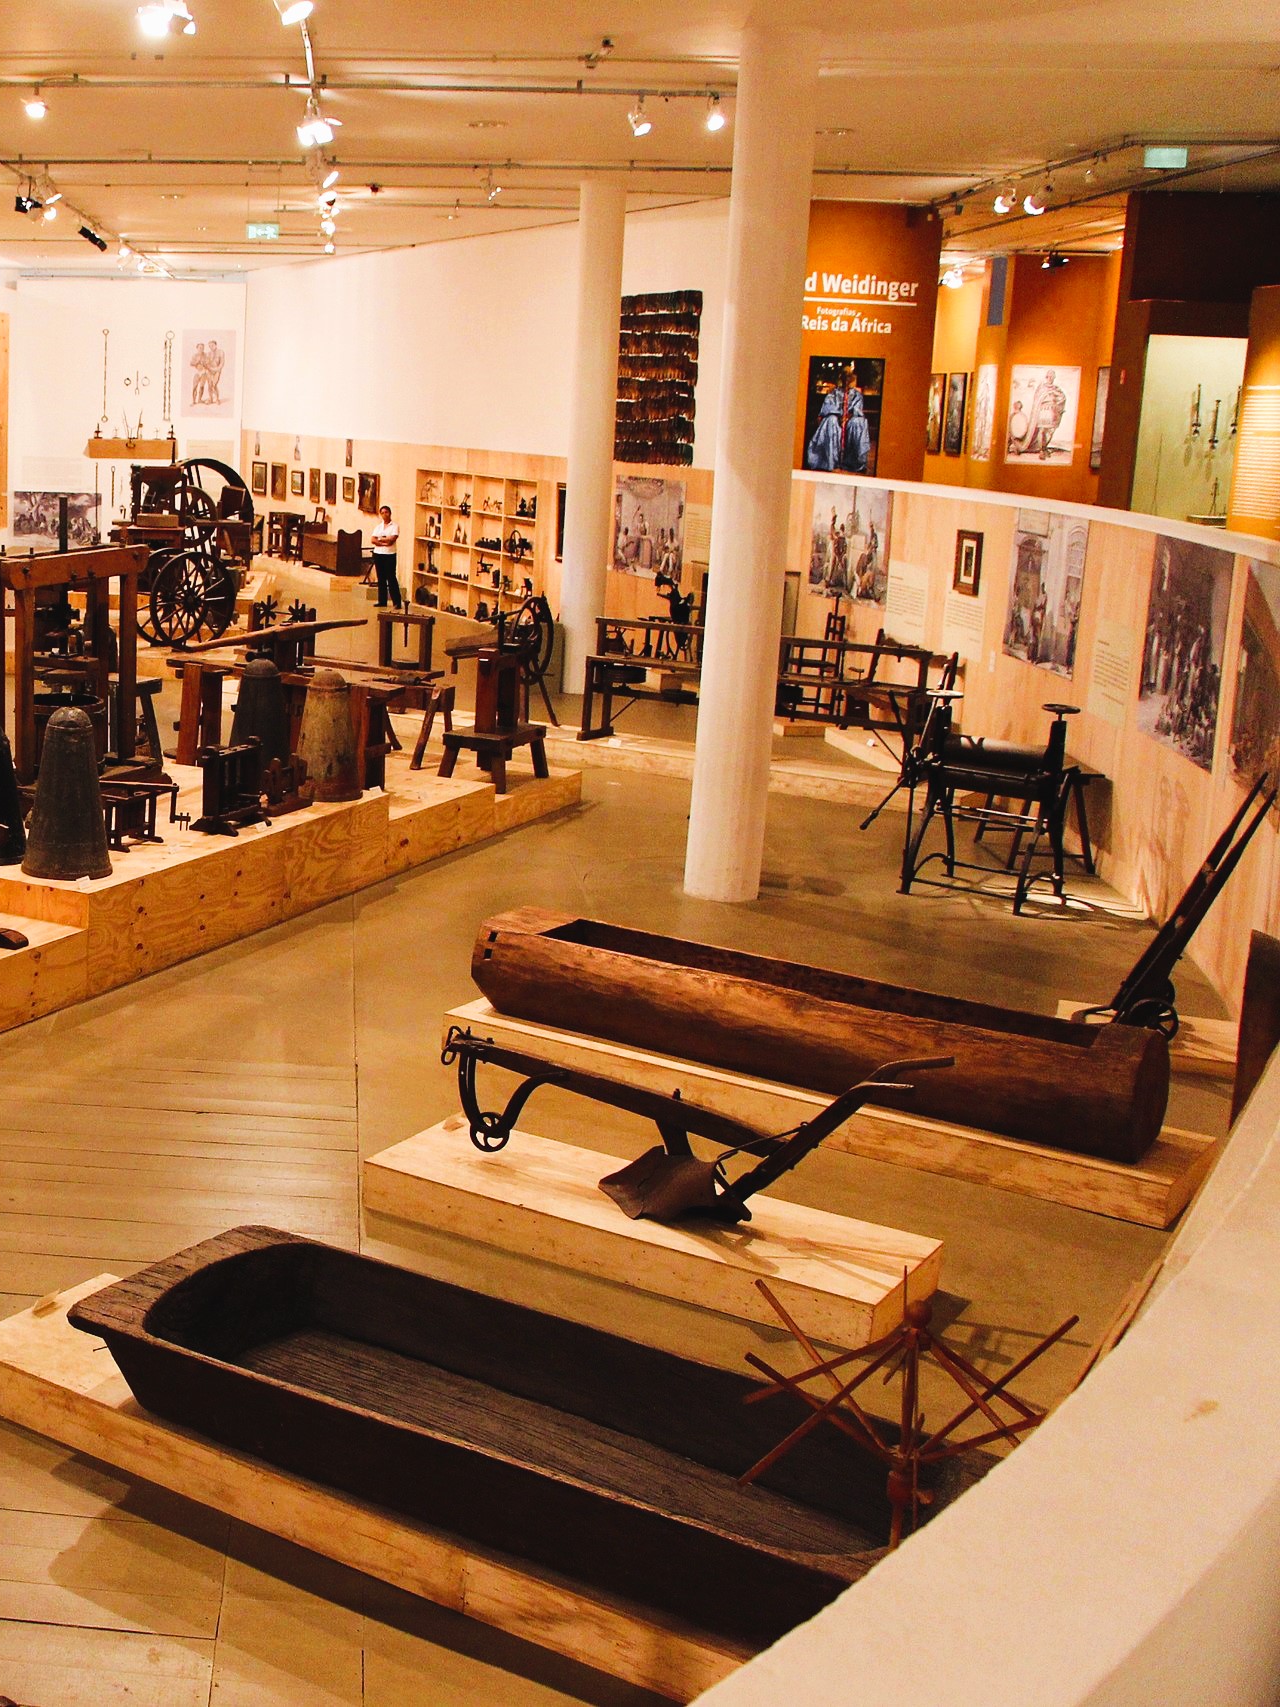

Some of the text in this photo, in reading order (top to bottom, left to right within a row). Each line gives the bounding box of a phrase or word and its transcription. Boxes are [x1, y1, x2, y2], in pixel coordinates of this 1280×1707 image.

[822, 272, 919, 301] Weidinger
[802, 311, 892, 334] Reis da África
[816, 306, 857, 317] Fotografias
